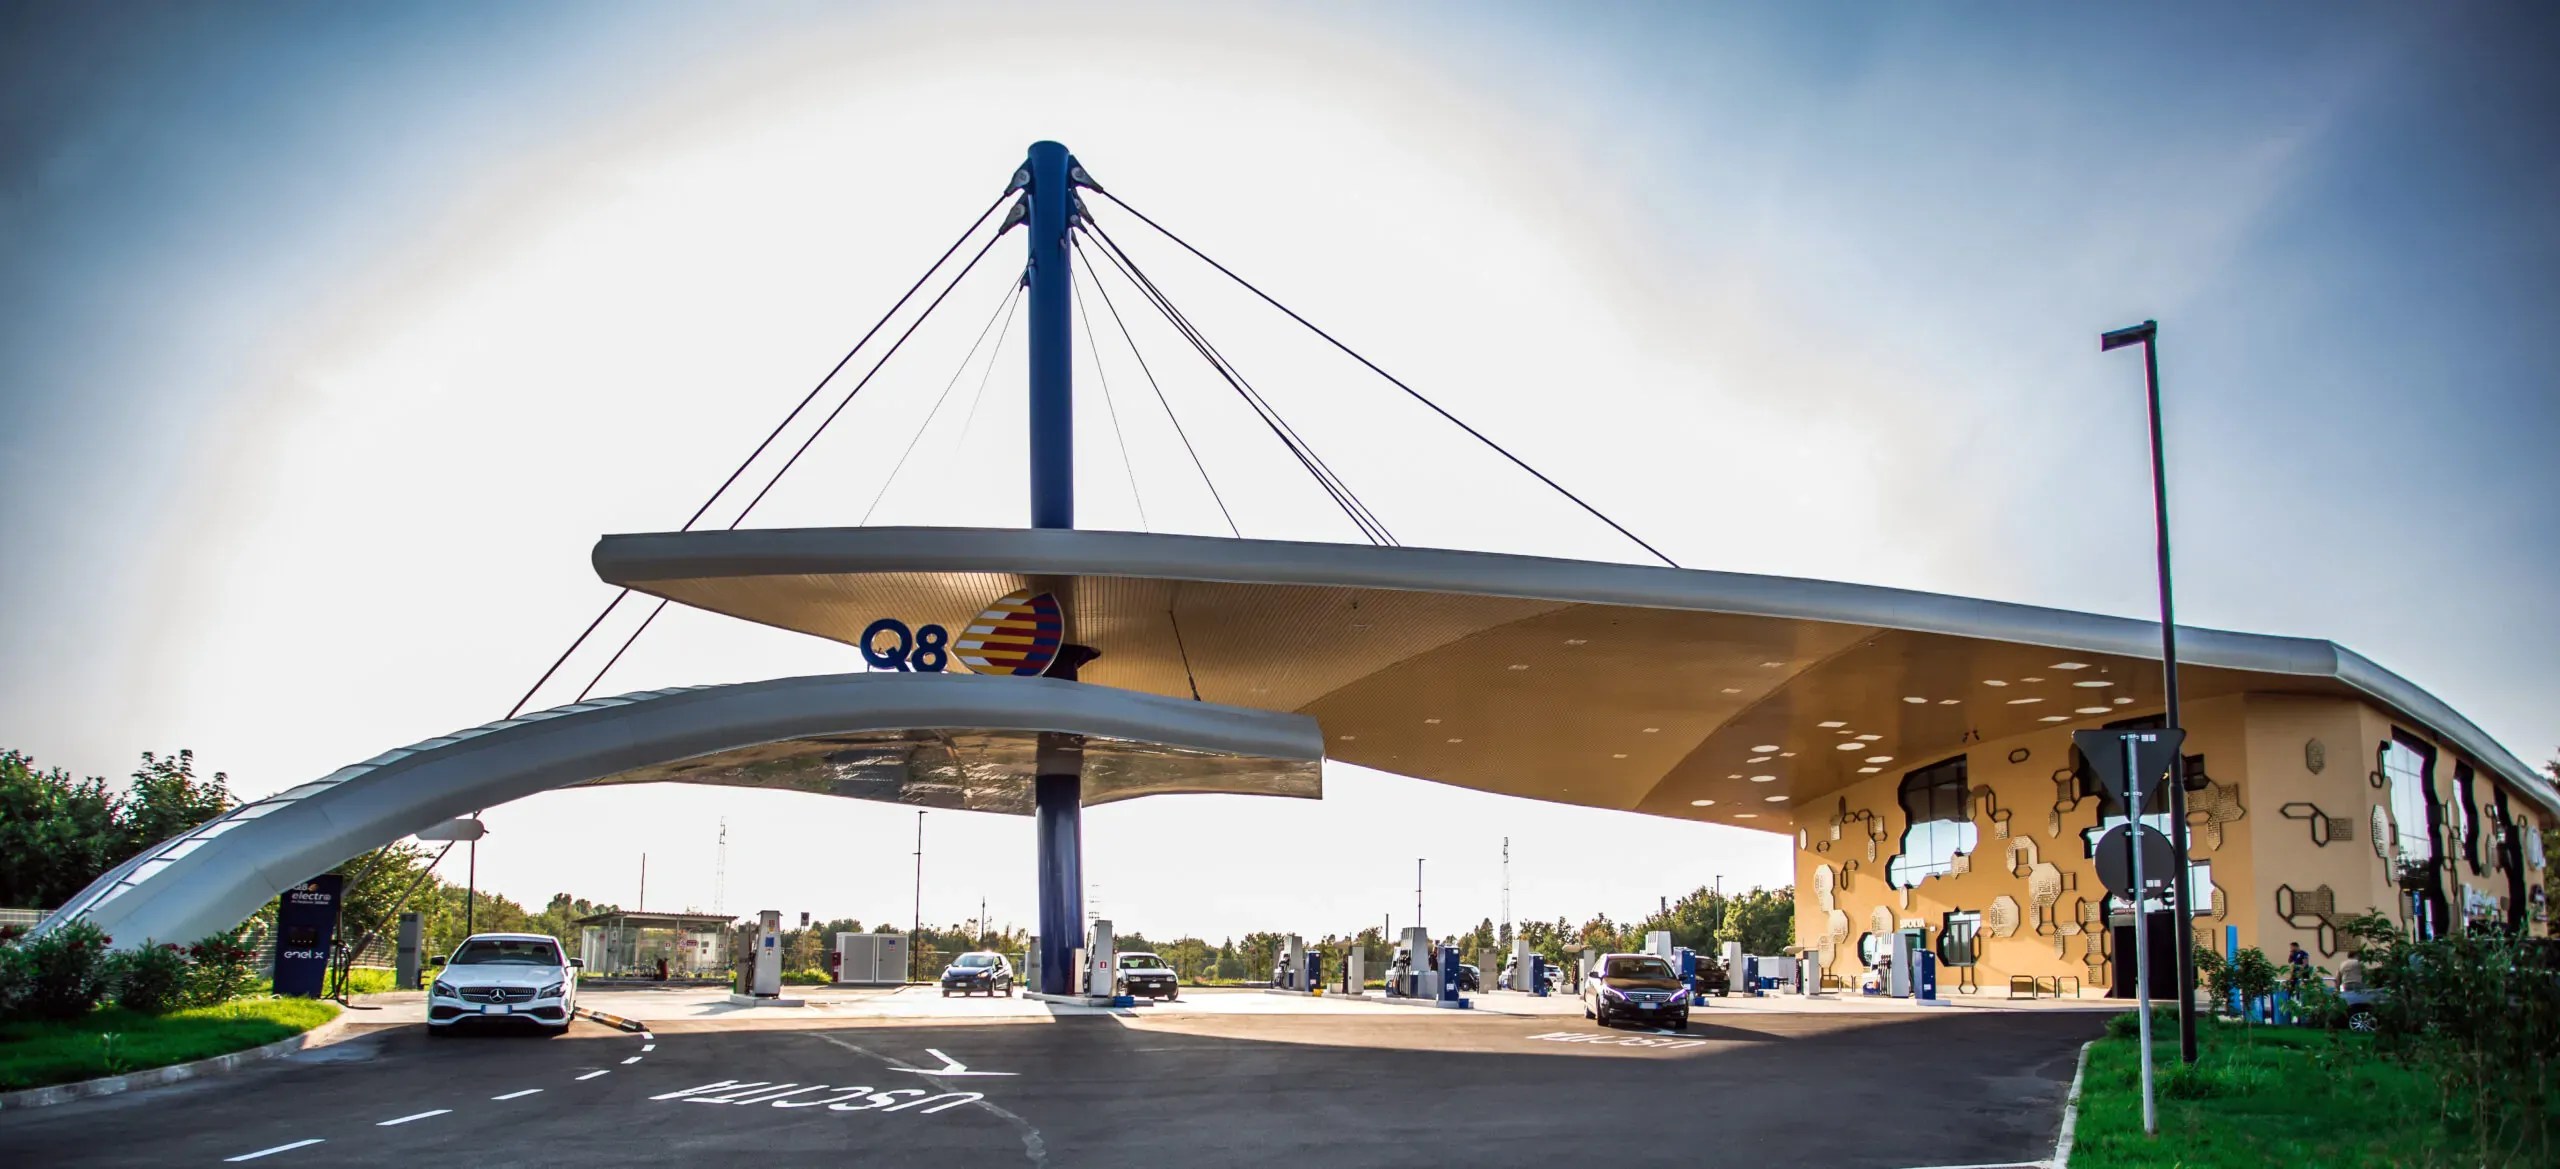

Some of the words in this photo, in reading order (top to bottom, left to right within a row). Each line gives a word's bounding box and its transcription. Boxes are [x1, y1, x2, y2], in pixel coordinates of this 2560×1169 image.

[860, 618, 949, 673] Q8
[284, 950, 312, 959] enel
[1525, 1031, 1707, 1049] USCITA
[648, 1079, 985, 1114] USCITA
